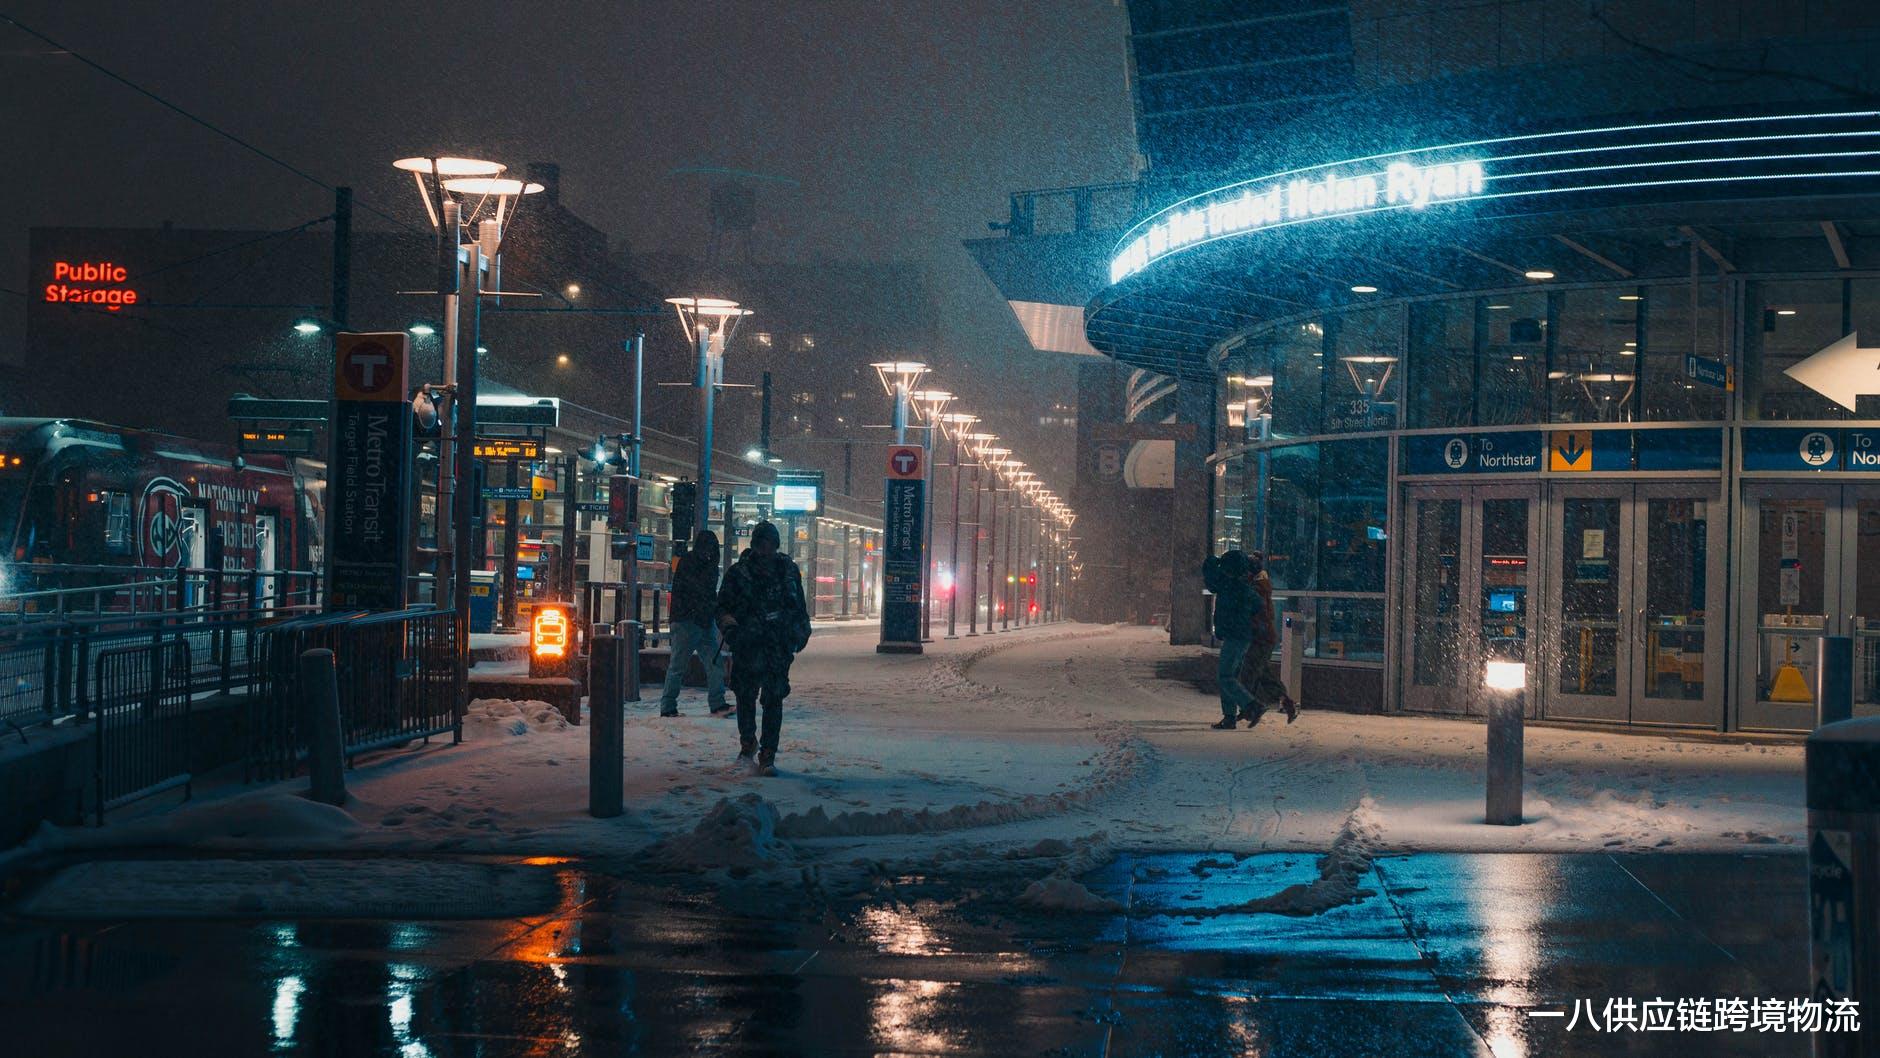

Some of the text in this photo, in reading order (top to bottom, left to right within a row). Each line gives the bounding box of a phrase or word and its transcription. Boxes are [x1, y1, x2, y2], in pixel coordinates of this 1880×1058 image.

[1288, 175, 1376, 218] Nolan
[1387, 161, 1483, 209] Ryan
[55, 261, 128, 282] Public
[45, 284, 137, 311] Storage
[351, 355, 388, 387] T
[1350, 400, 1370, 415] 335
[345, 413, 360, 452] Target
[1851, 432, 1872, 448] To
[1480, 438, 1493, 451] To
[895, 455, 915, 473] T
[1480, 452, 1537, 468] Northstar
[343, 489, 358, 534] Station
